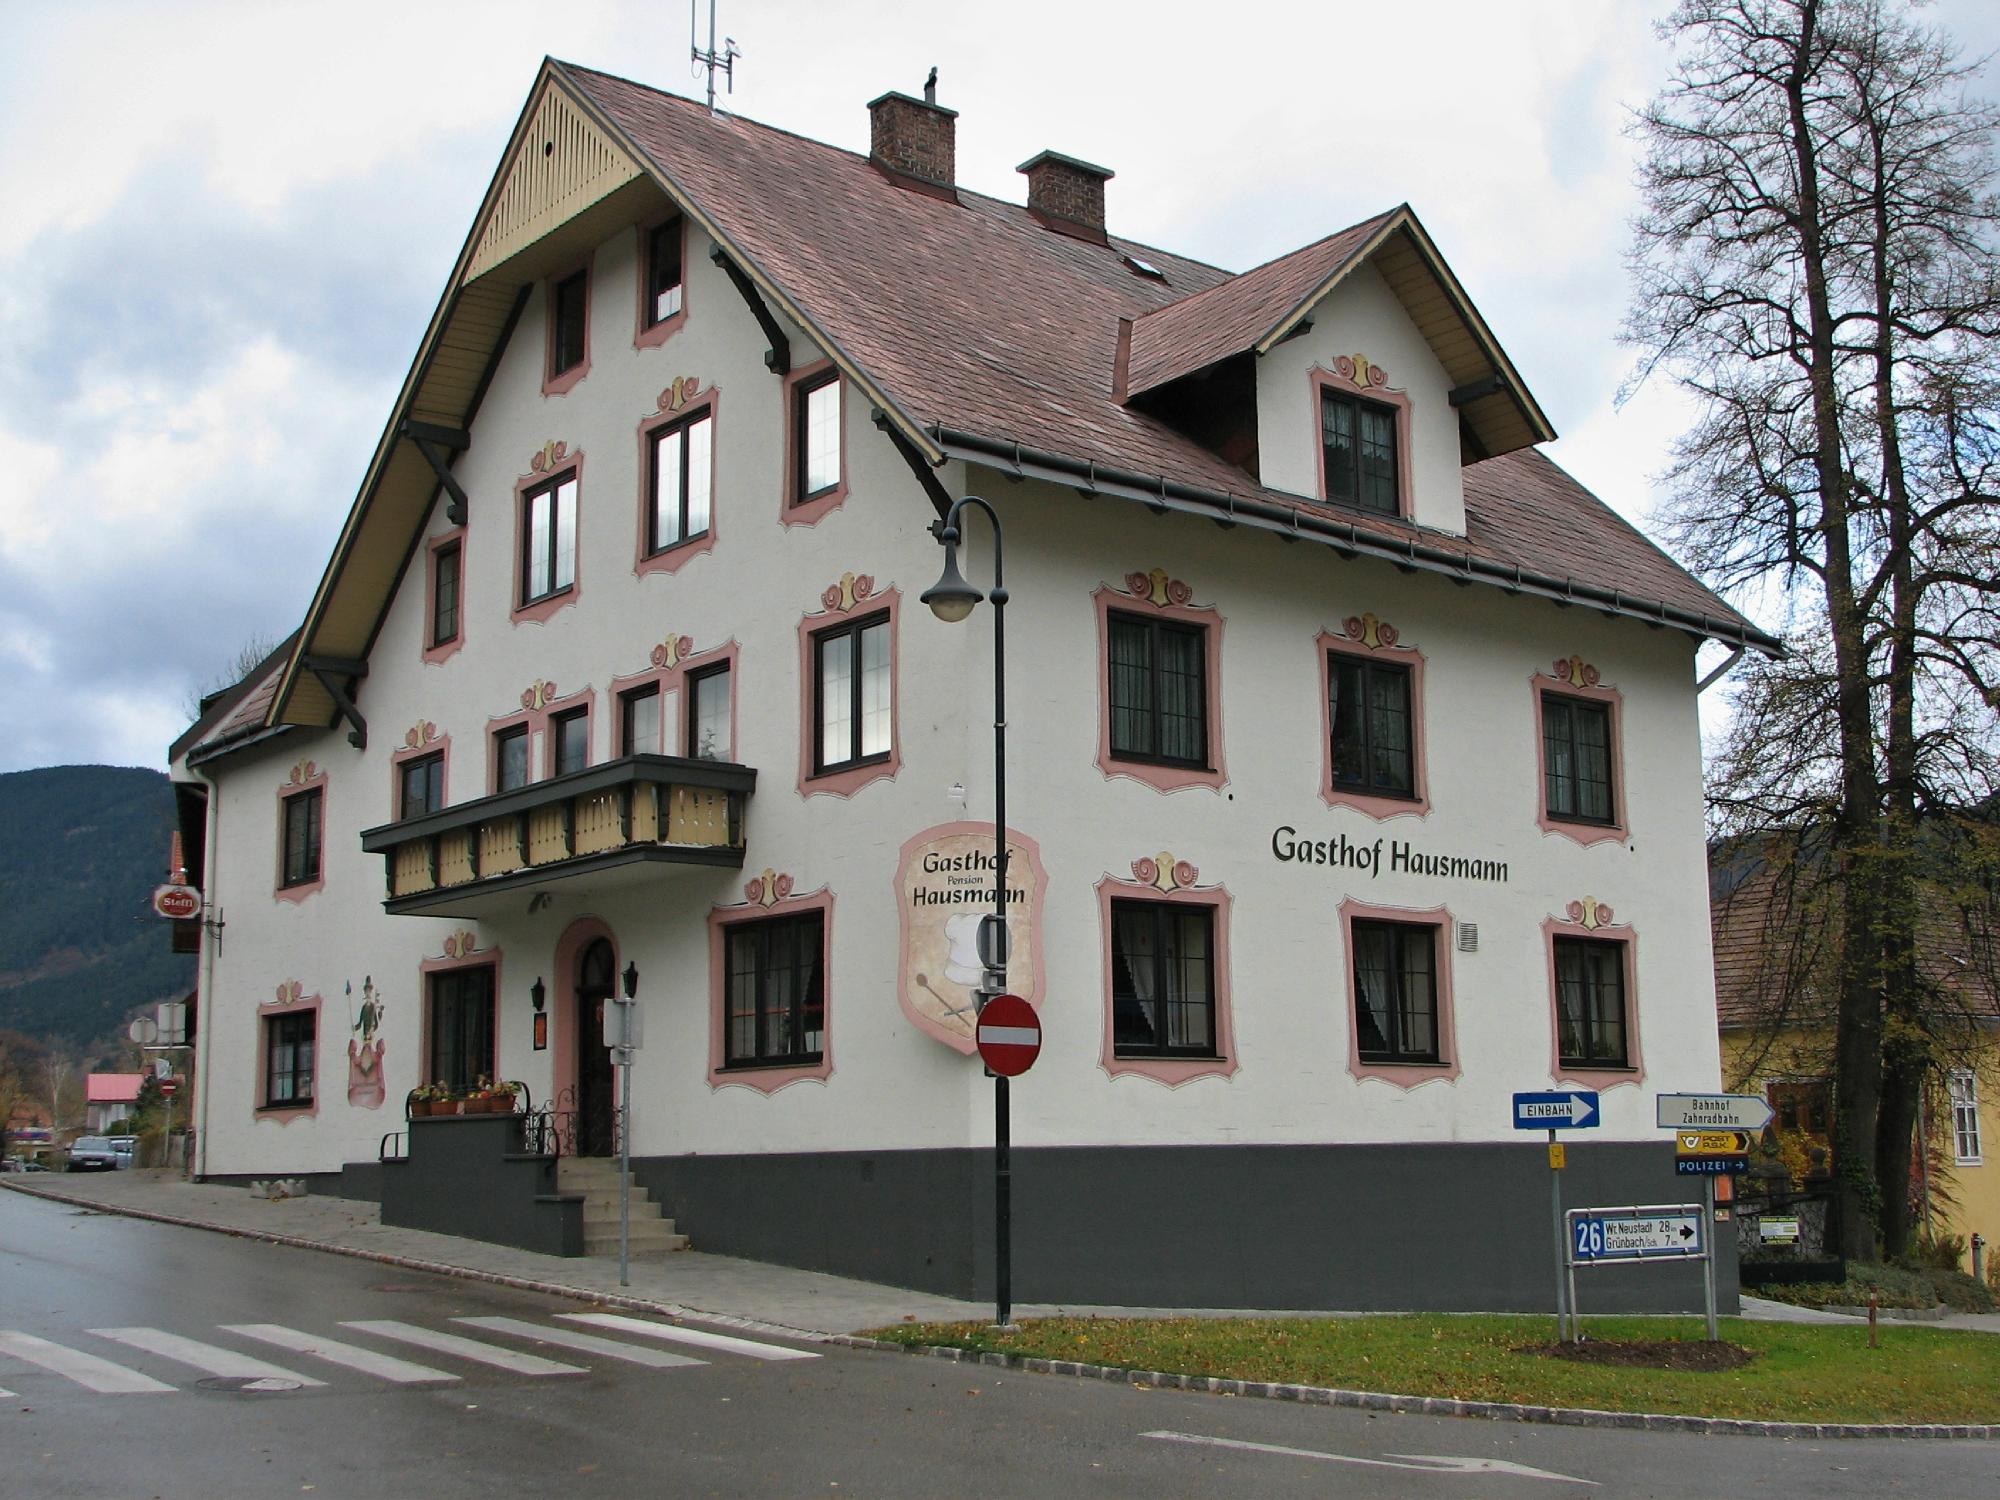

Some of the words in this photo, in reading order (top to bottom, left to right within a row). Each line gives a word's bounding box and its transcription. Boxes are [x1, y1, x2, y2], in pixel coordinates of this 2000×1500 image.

[1272, 825, 1384, 879] Gasthof
[1391, 841, 1508, 882] Hausmann
[947, 875, 983, 885] Pension
[1527, 1104, 1572, 1116] EINBAHN
[1693, 1099, 1730, 1110] Bahnhof
[1683, 1112, 1739, 1124] Zahnradbahn
[1679, 1161, 1726, 1171] POLIZEI
[1659, 1221, 1671, 1233] 28
[1577, 1222, 1602, 1252] 26
[1665, 1235, 1671, 1246] 7
